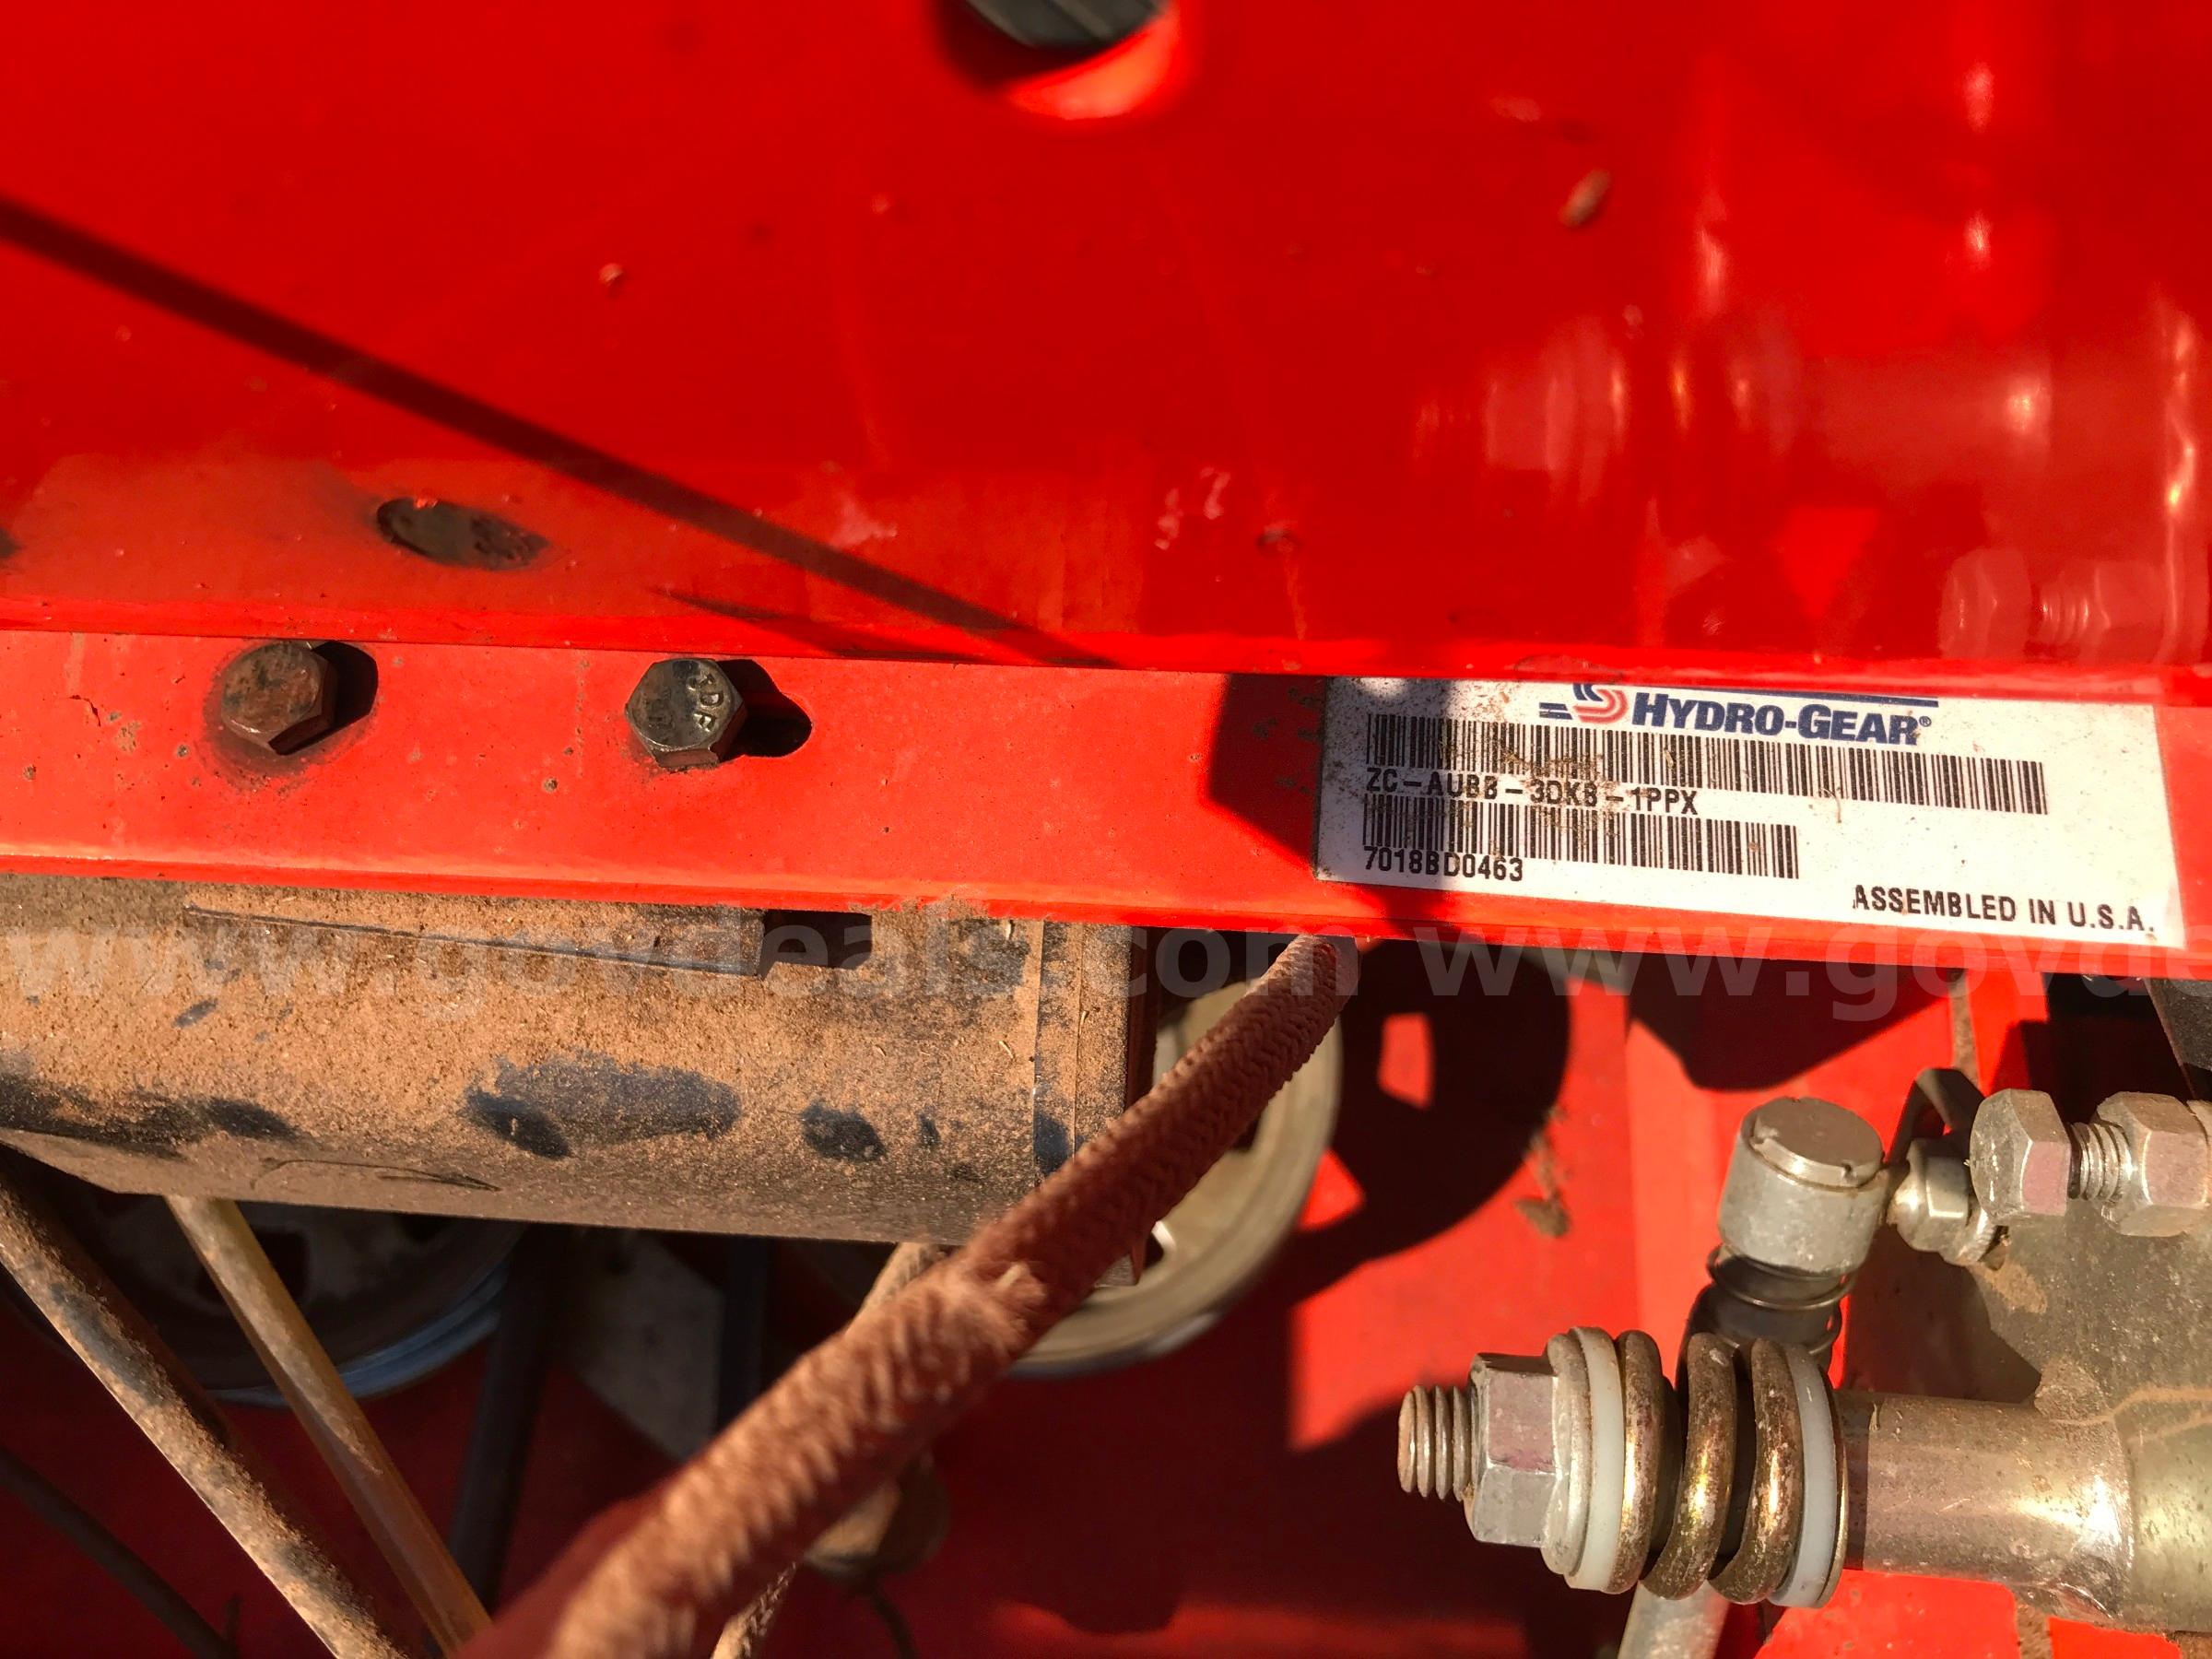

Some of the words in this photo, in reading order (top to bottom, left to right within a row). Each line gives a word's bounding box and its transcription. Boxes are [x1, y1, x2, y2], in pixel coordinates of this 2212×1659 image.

[1853, 884, 2017, 922] ASSEMBLED
[2029, 898, 2056, 925] IN
[2066, 901, 2155, 933] U.S.A.
